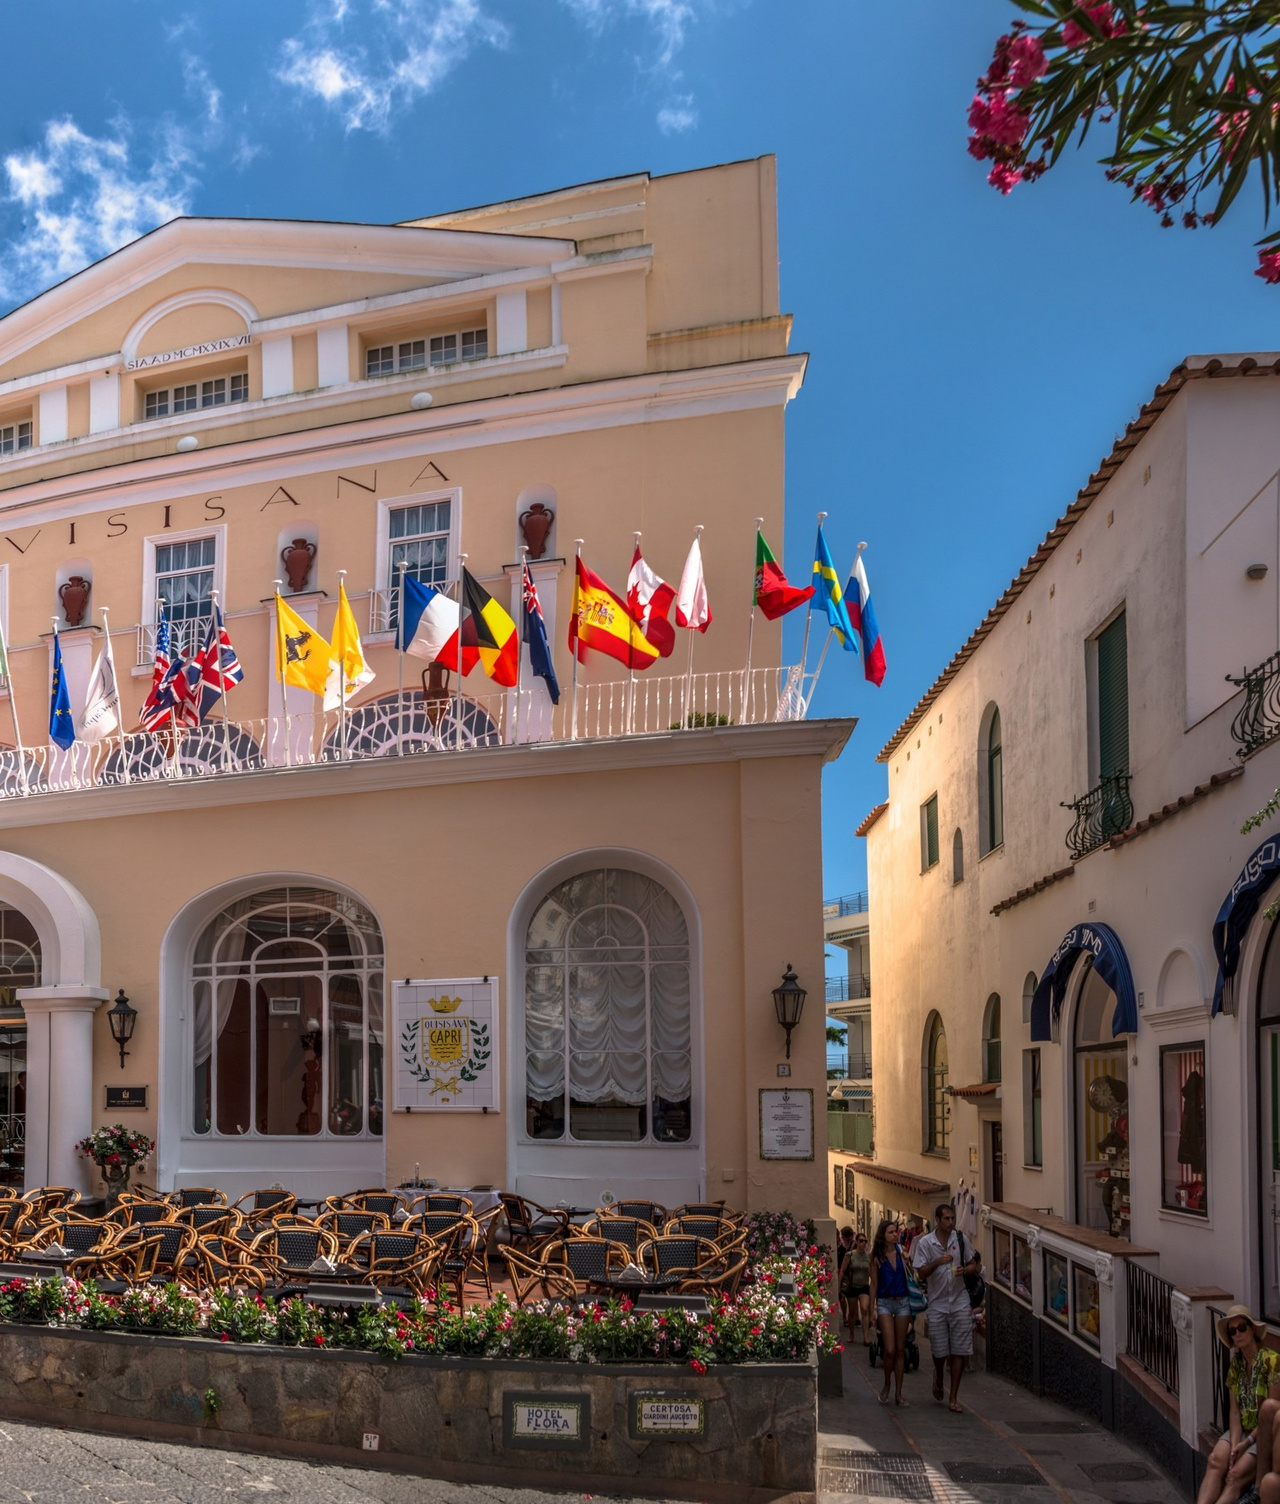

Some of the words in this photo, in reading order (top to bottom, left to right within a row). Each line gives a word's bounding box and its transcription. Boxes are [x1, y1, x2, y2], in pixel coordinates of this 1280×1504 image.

[424, 1019, 468, 1029] QUISISANA
[430, 1030, 461, 1043] CAPRI
[650, 1404, 692, 1413] CERTOSA
[527, 1409, 563, 1419] HOTEL
[527, 1418, 569, 1428] FLORA
